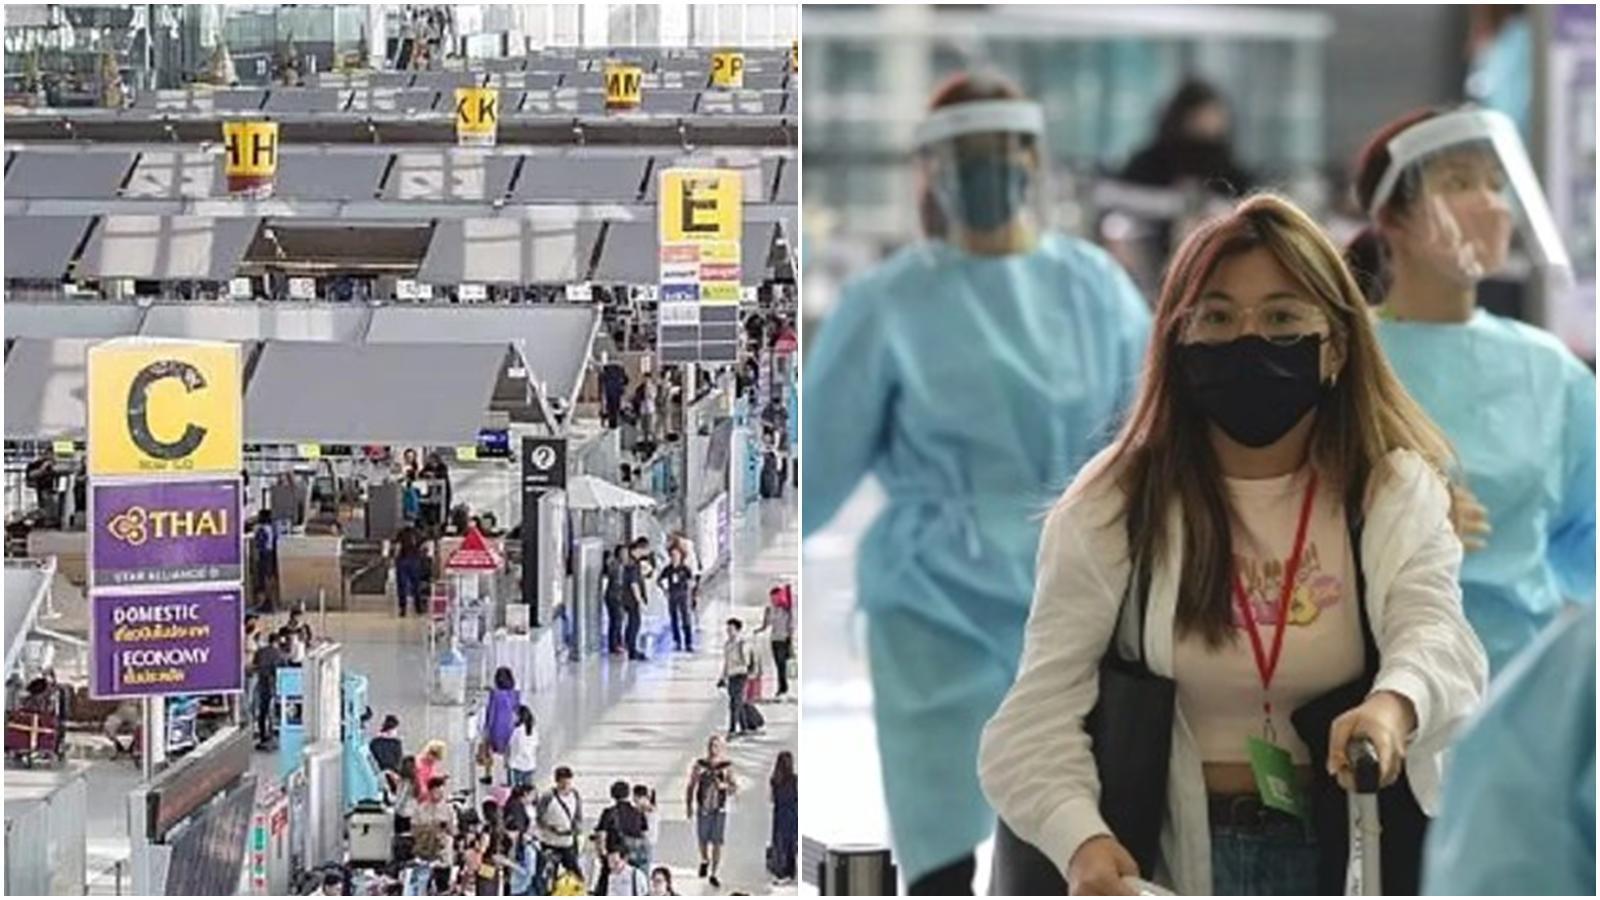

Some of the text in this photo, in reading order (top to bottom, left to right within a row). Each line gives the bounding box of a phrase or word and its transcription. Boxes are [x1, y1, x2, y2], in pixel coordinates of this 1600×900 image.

[681, 178, 720, 233] E
[126, 359, 208, 461] C
[149, 508, 228, 539] THAI
[113, 603, 201, 625] DOMESTIC
[122, 647, 210, 667] ECONOMY
